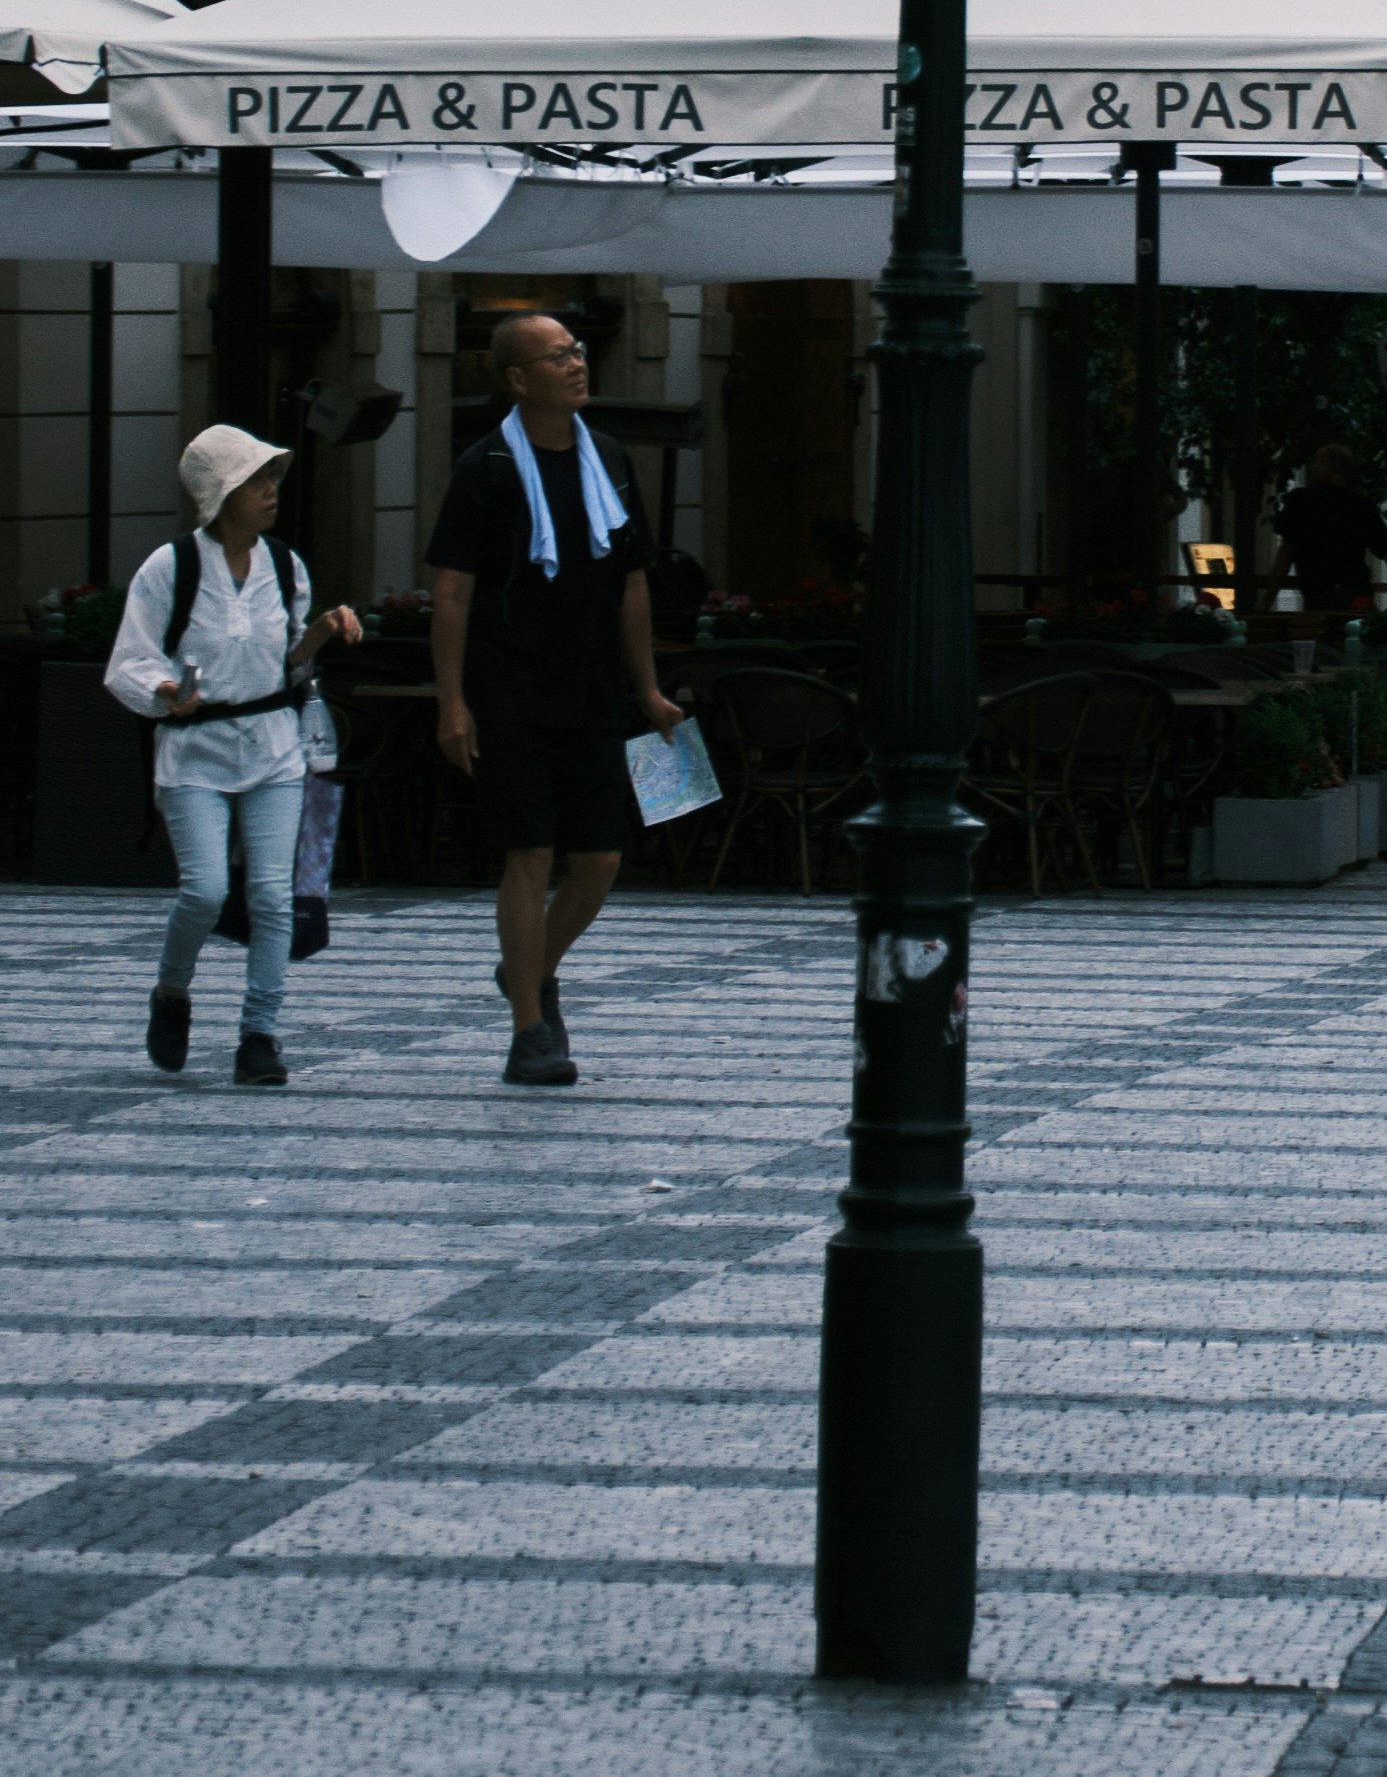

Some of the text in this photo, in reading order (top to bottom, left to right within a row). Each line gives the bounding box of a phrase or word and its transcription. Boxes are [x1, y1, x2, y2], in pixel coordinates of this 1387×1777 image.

[228, 81, 705, 134] PIZZA & PASTA
[882, 83, 1064, 131] PZA
[1086, 81, 1132, 130] &
[1156, 81, 1357, 130] PASTA
